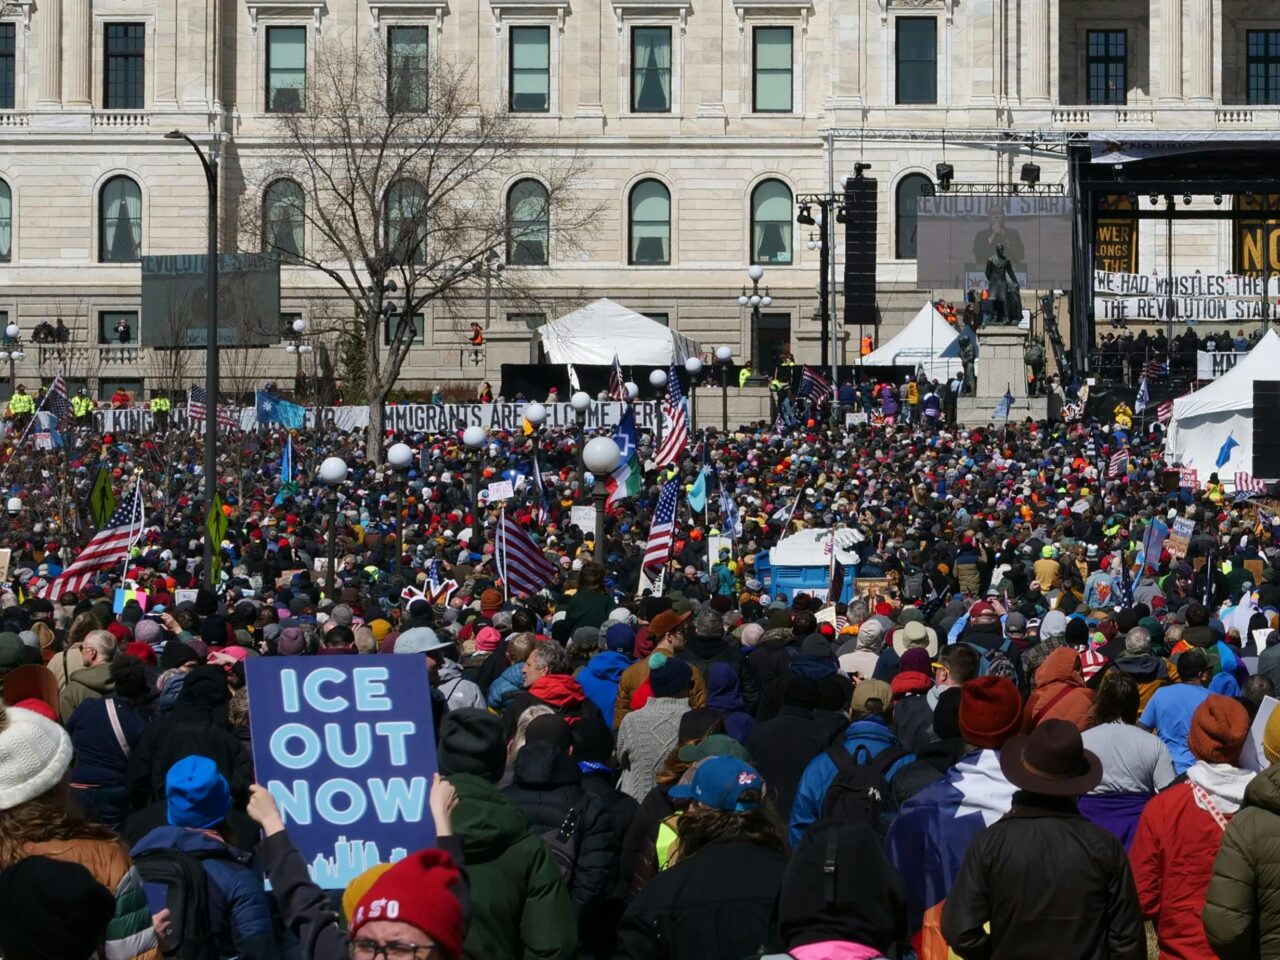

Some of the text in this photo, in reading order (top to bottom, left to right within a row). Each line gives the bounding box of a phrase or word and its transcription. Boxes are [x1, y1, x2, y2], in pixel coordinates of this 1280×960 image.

[1097, 271, 1114, 291] WE
[1120, 275, 1149, 294] HAD
[1233, 274, 1267, 296] THE
[1102, 298, 1129, 319] THE
[1137, 298, 1227, 320] REVOLUTION
[112, 409, 154, 434] KING
[385, 404, 482, 432] MMIGRANTS
[490, 403, 524, 429] ARE
[543, 402, 611, 428] ELCME
[281, 667, 392, 713] ICE
[270, 721, 416, 769] OUT
[267, 776, 426, 825] NOW
